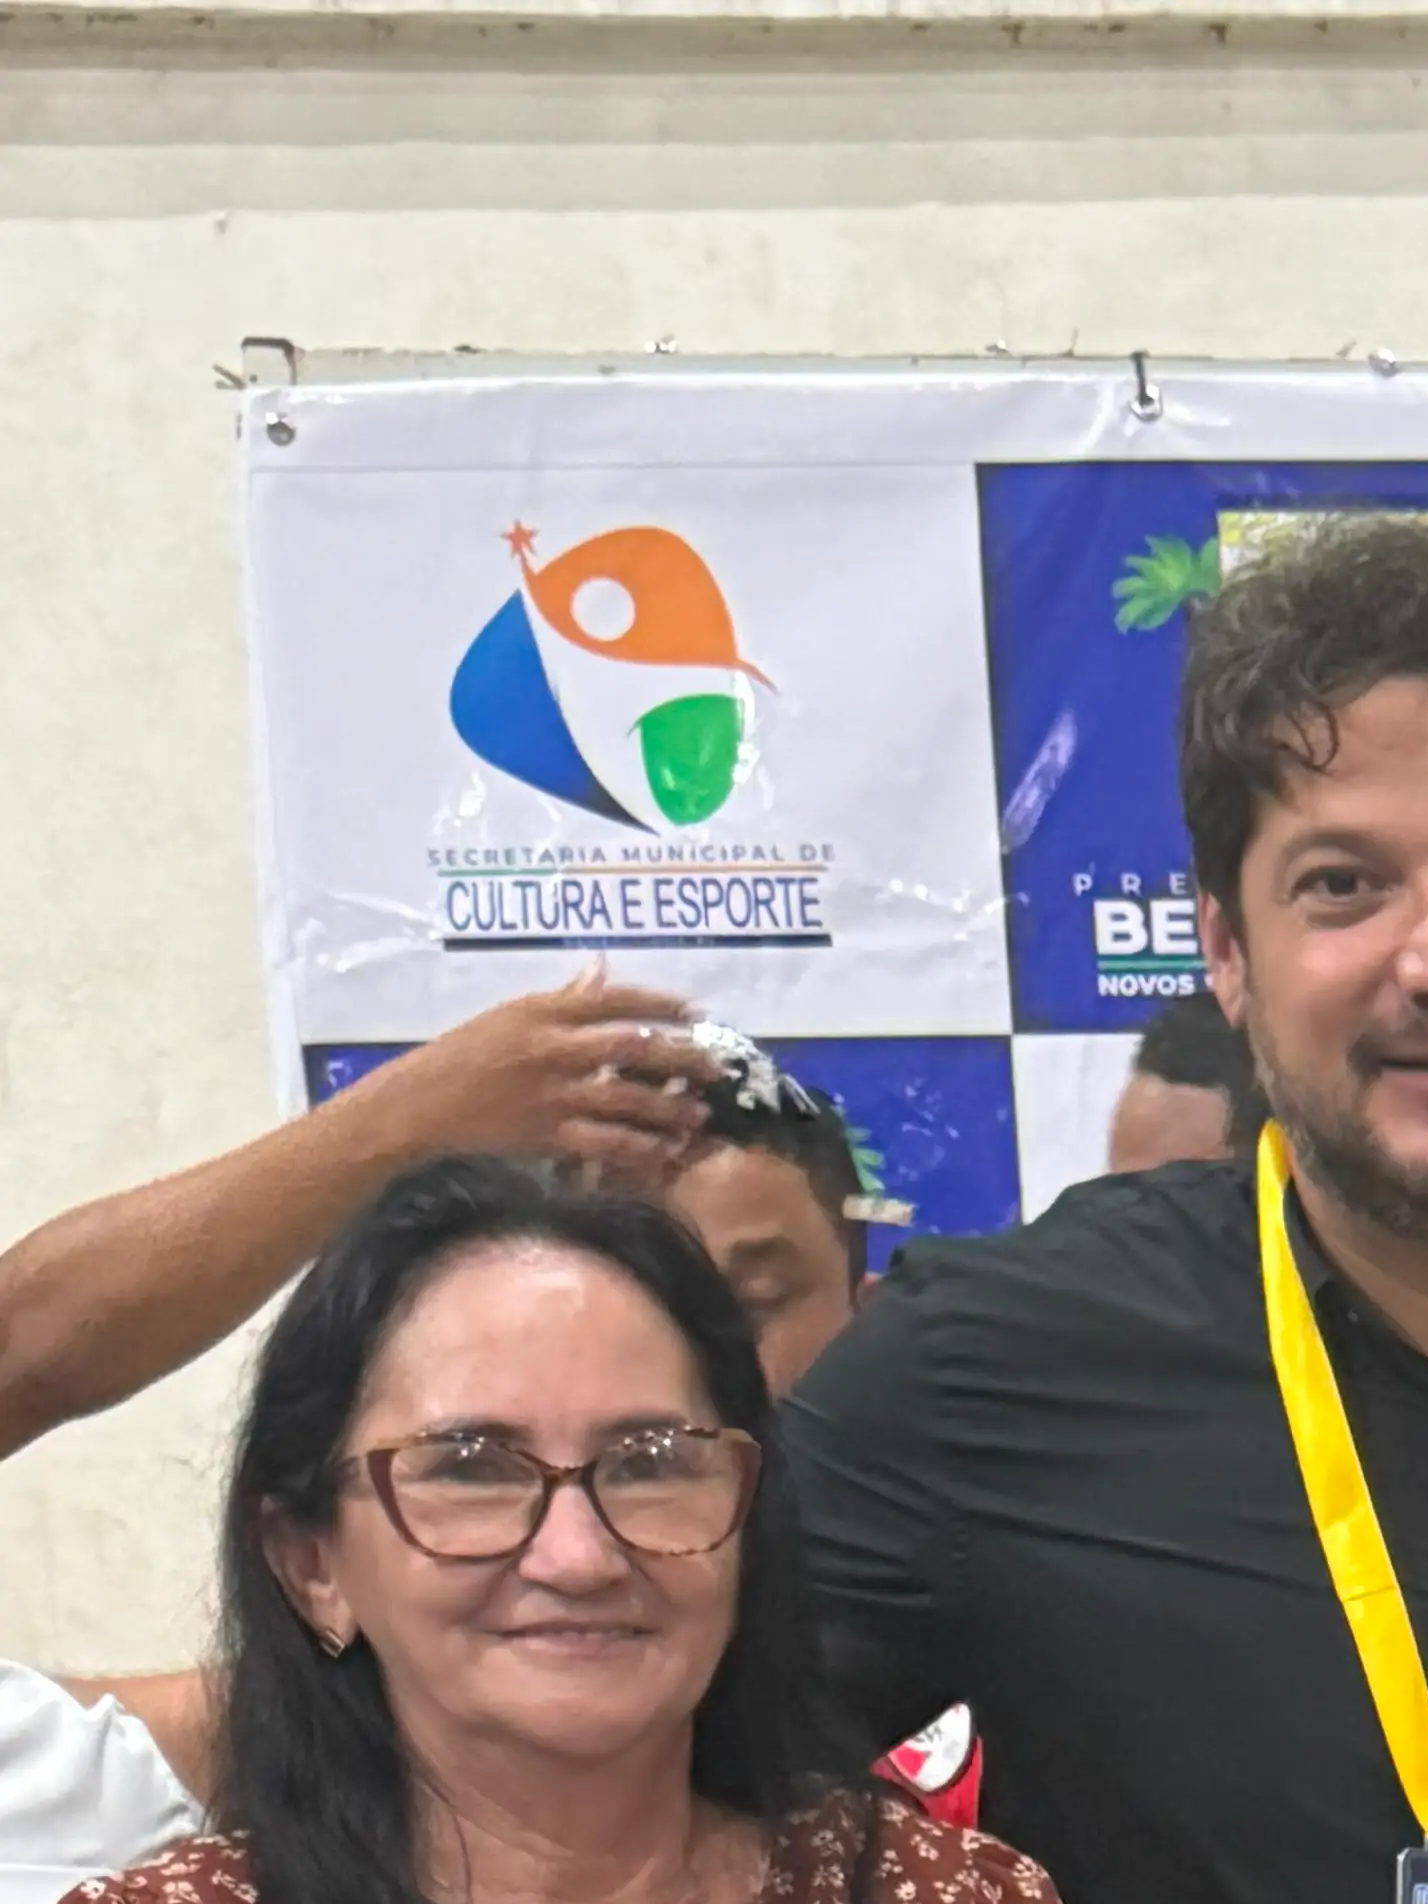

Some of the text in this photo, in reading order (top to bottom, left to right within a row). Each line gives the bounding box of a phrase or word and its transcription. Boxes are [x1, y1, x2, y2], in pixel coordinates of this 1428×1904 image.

[426, 842, 838, 867] SECRETARIA MUNICIPAL DE
[445, 876, 824, 932] CULTURA E ESPORTE
[1097, 974, 1196, 997] NOVOS
